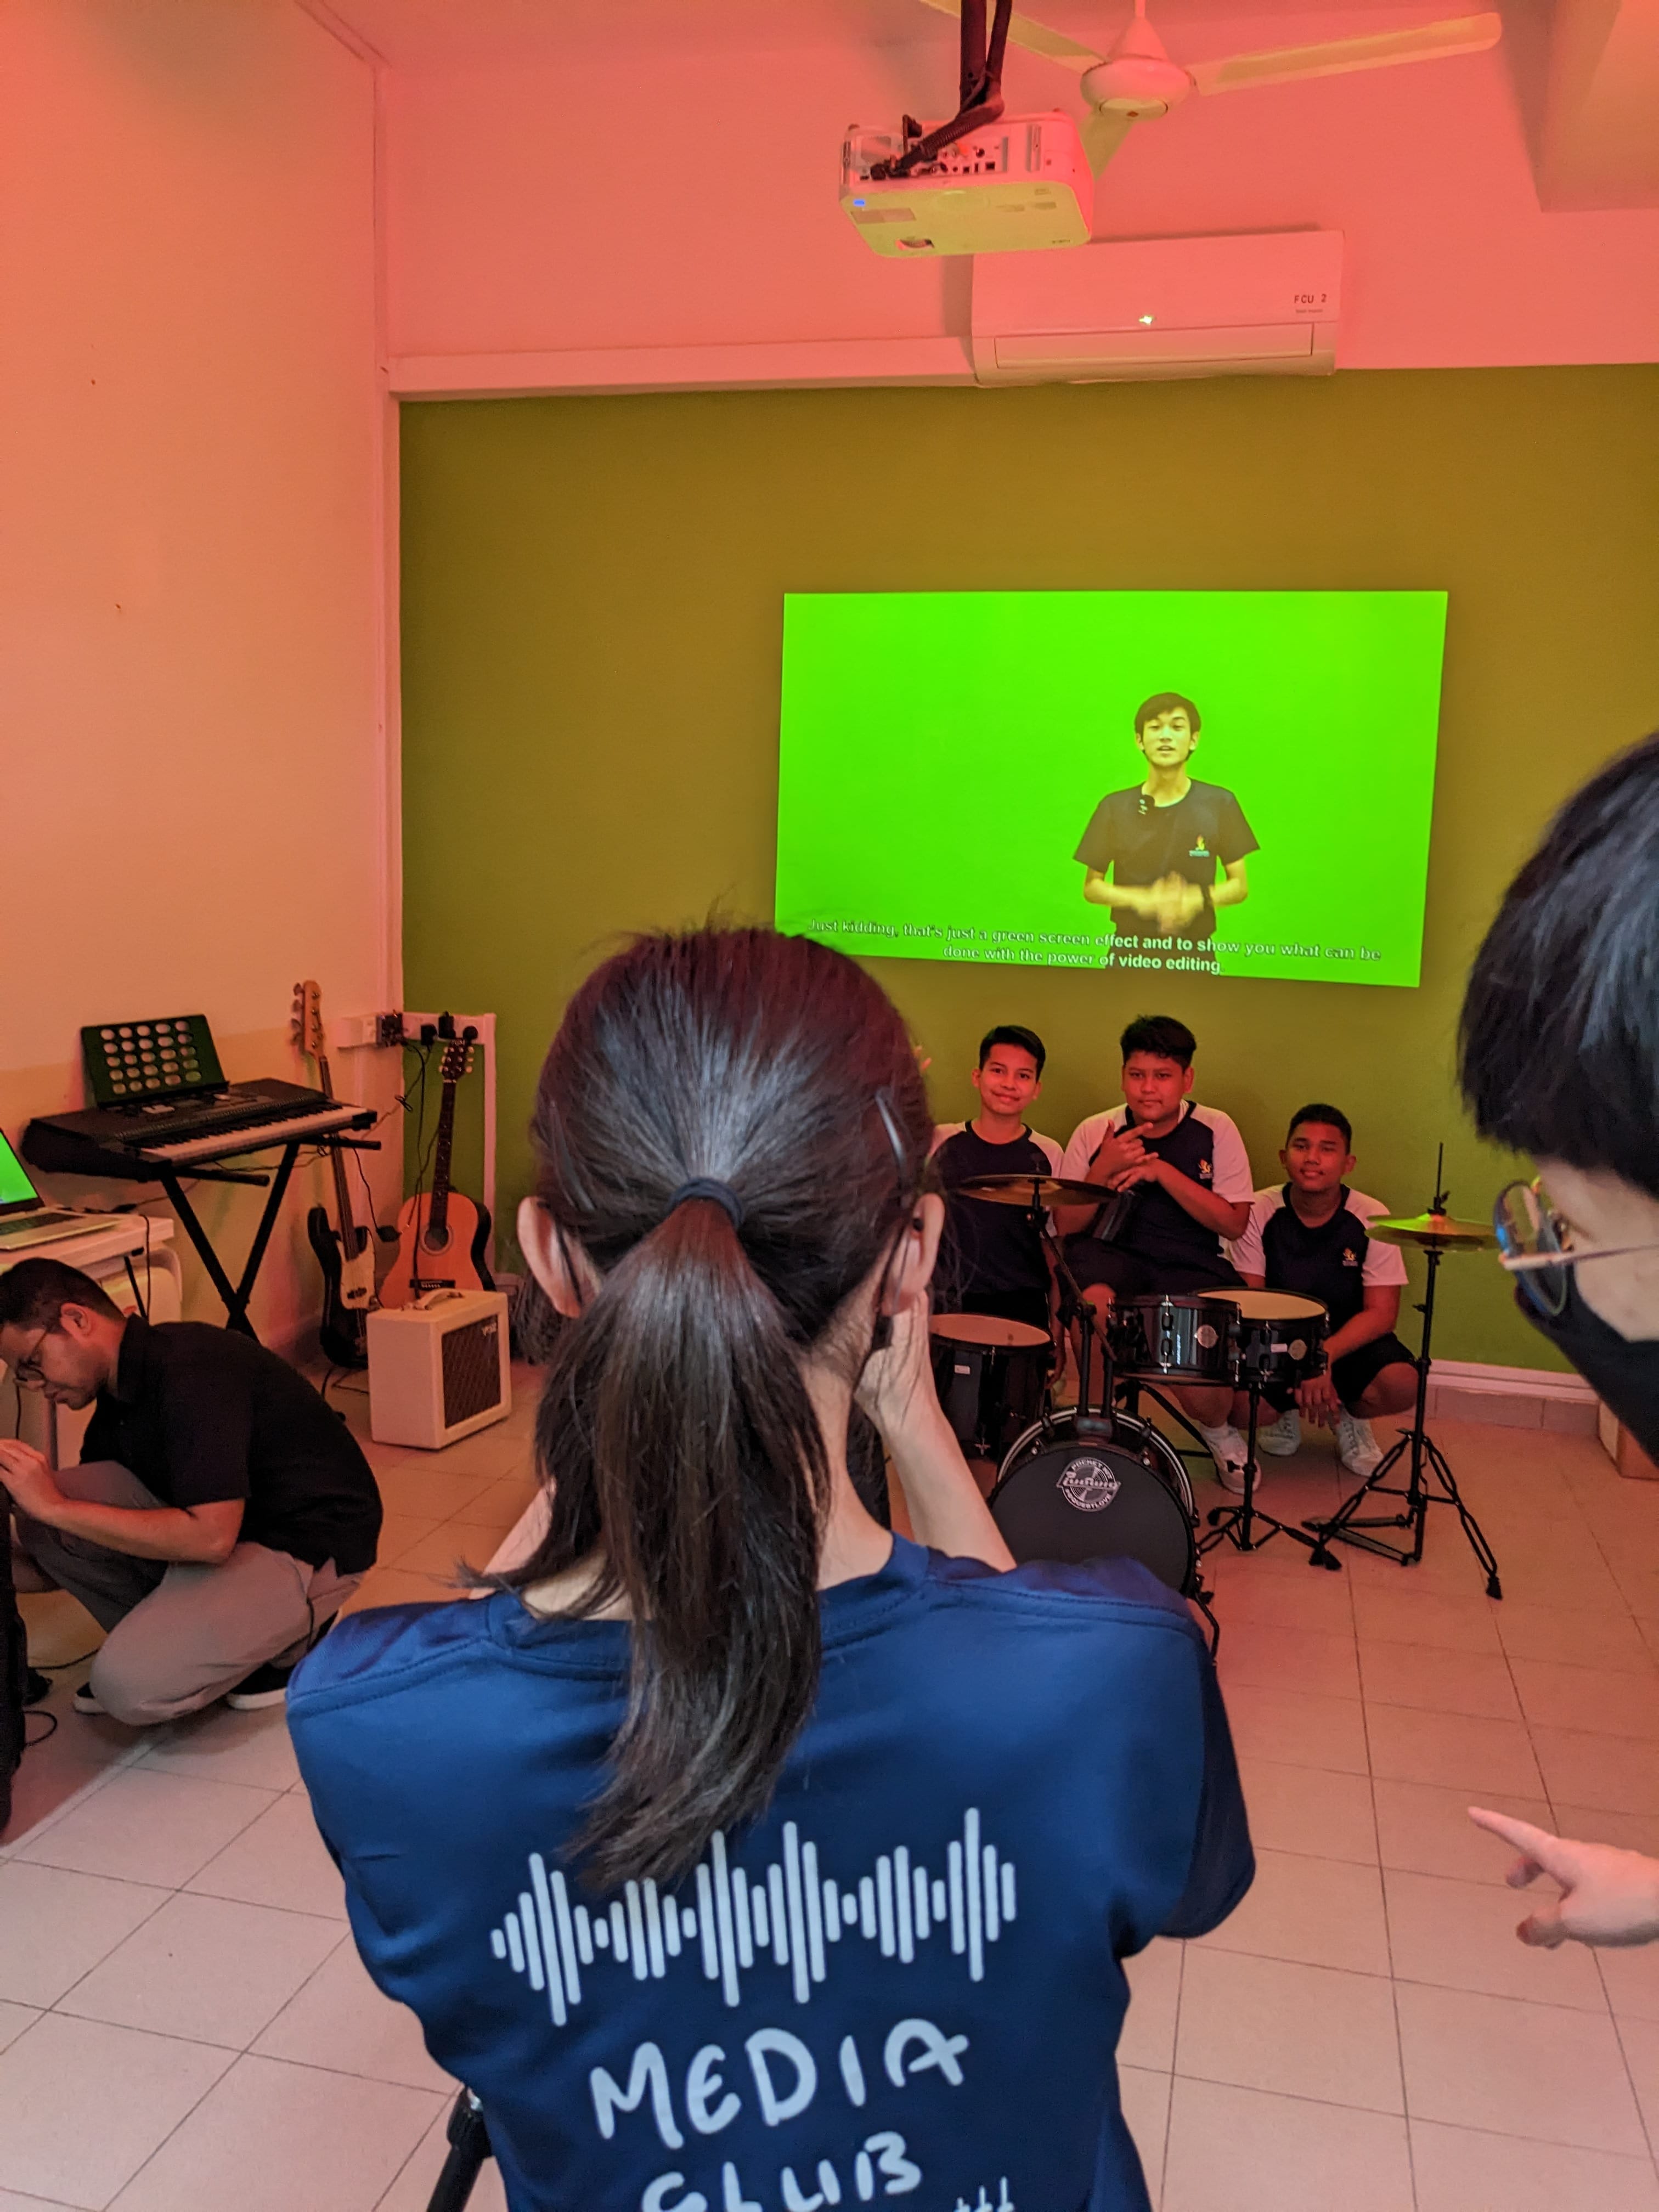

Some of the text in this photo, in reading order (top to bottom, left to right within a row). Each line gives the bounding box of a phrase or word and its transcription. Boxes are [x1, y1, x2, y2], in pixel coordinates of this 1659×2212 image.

[1294, 294, 1327, 303] FCU 2
[808, 918, 1381, 961] Just kidding, that's just a green screen effect and to show you what can be
[943, 945, 980, 958] done
[984, 947, 1015, 960] with
[1019, 949, 1043, 961] the
[1047, 952, 1094, 965] power
[1099, 953, 1115, 966] of
[1119, 952, 1162, 968] video
[589, 2018, 969, 2149] MEDIA
